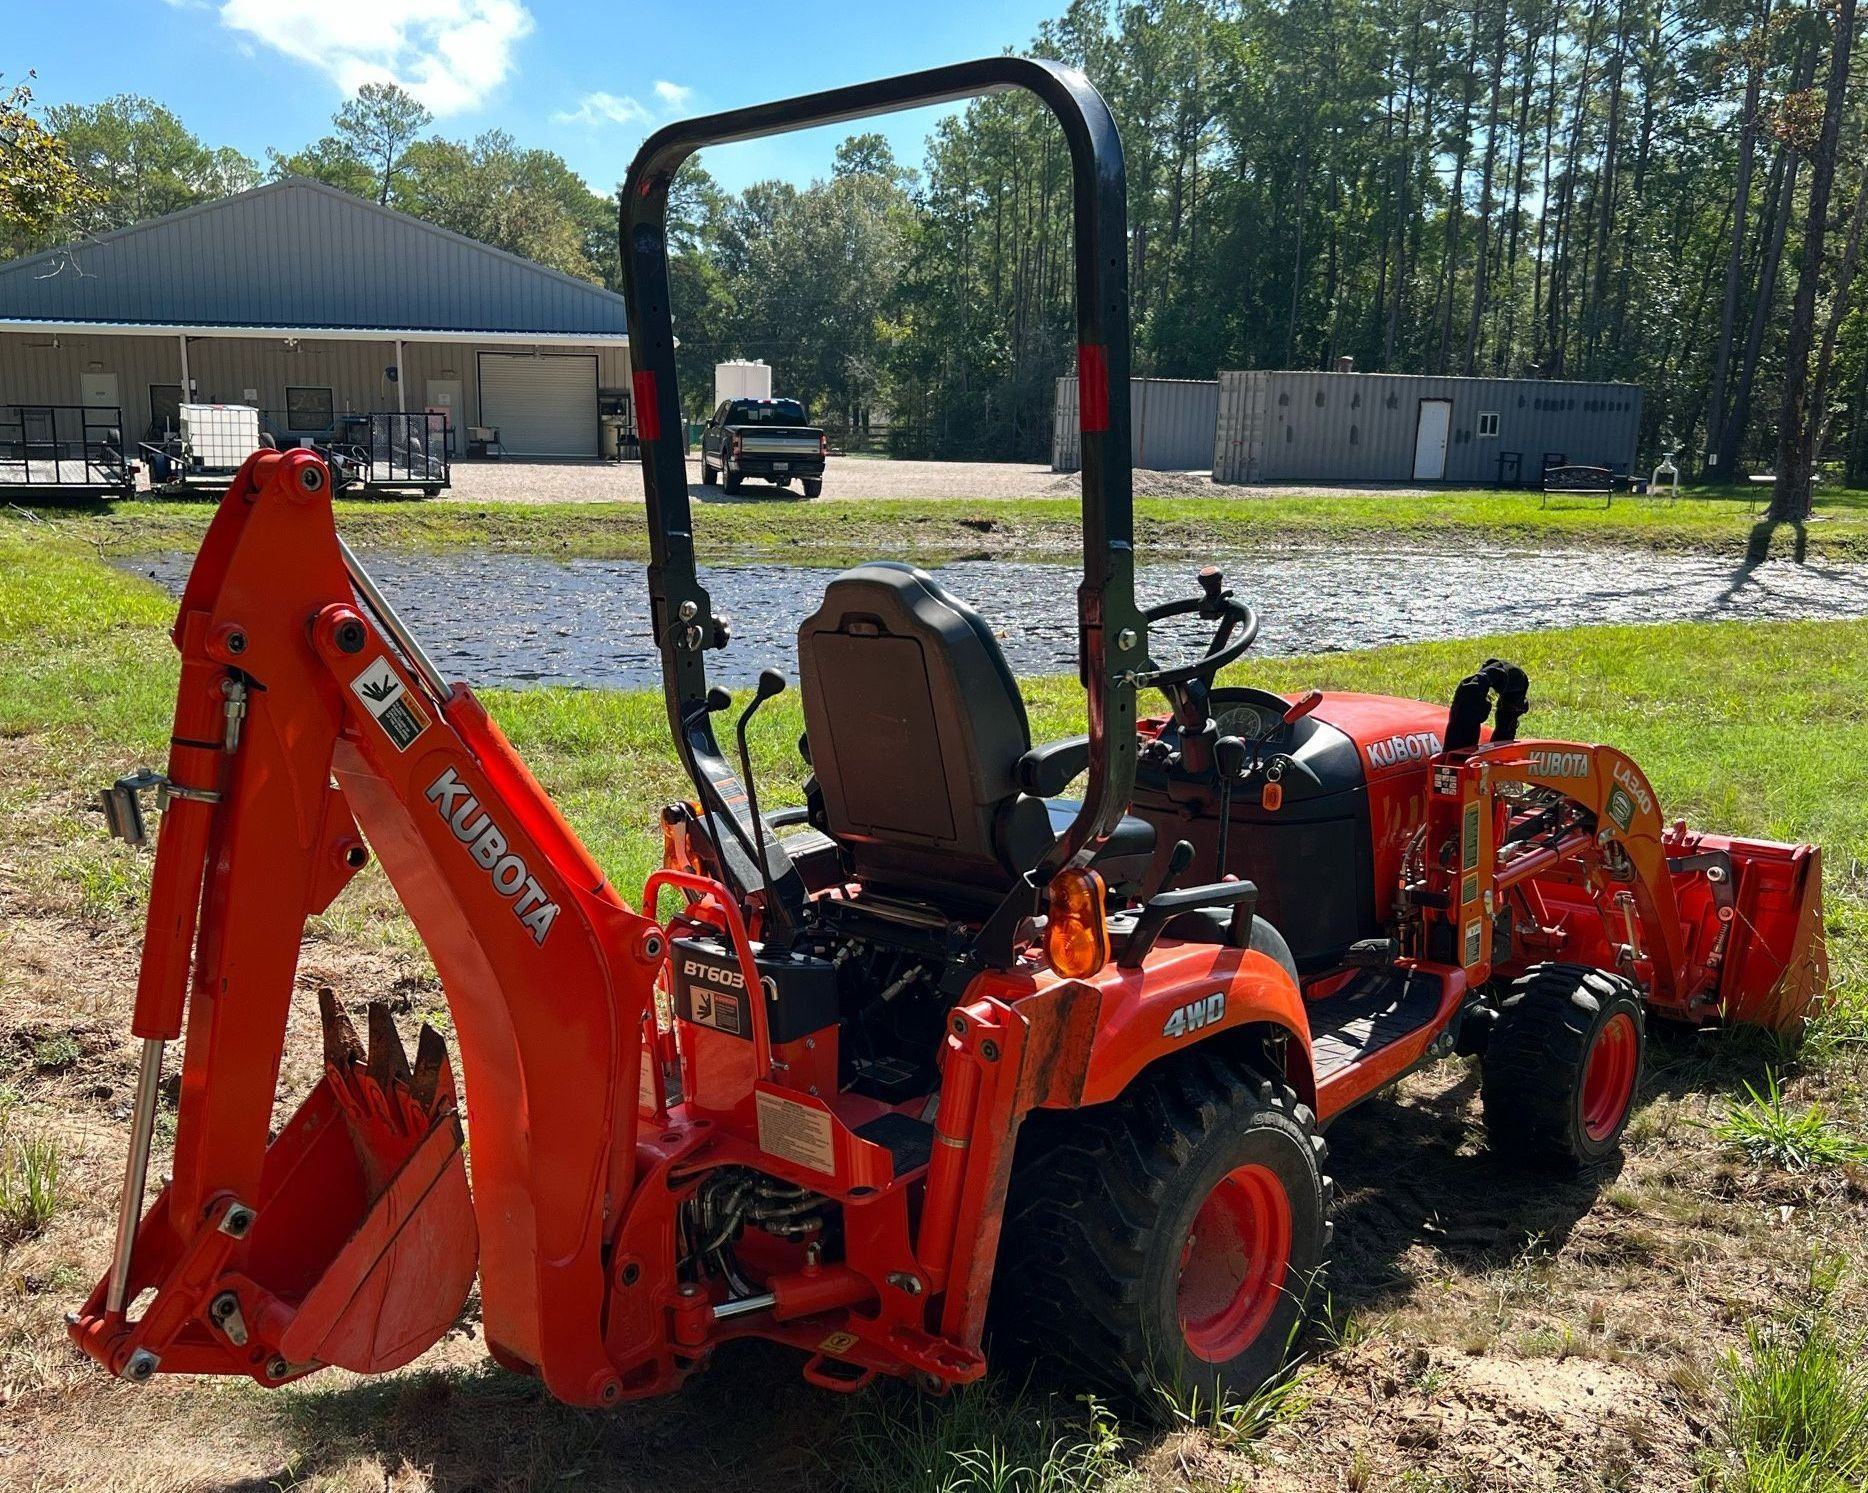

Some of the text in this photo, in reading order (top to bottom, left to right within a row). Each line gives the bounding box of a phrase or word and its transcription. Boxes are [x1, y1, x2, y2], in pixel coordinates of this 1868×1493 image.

[1366, 732, 1442, 769] KUBOTA
[1528, 752, 1589, 778] KUBOTA
[1613, 761, 1652, 814] LA340
[426, 767, 558, 949] KUBOTA
[684, 960, 745, 989] BT603
[1163, 992, 1225, 1038] 4WD
